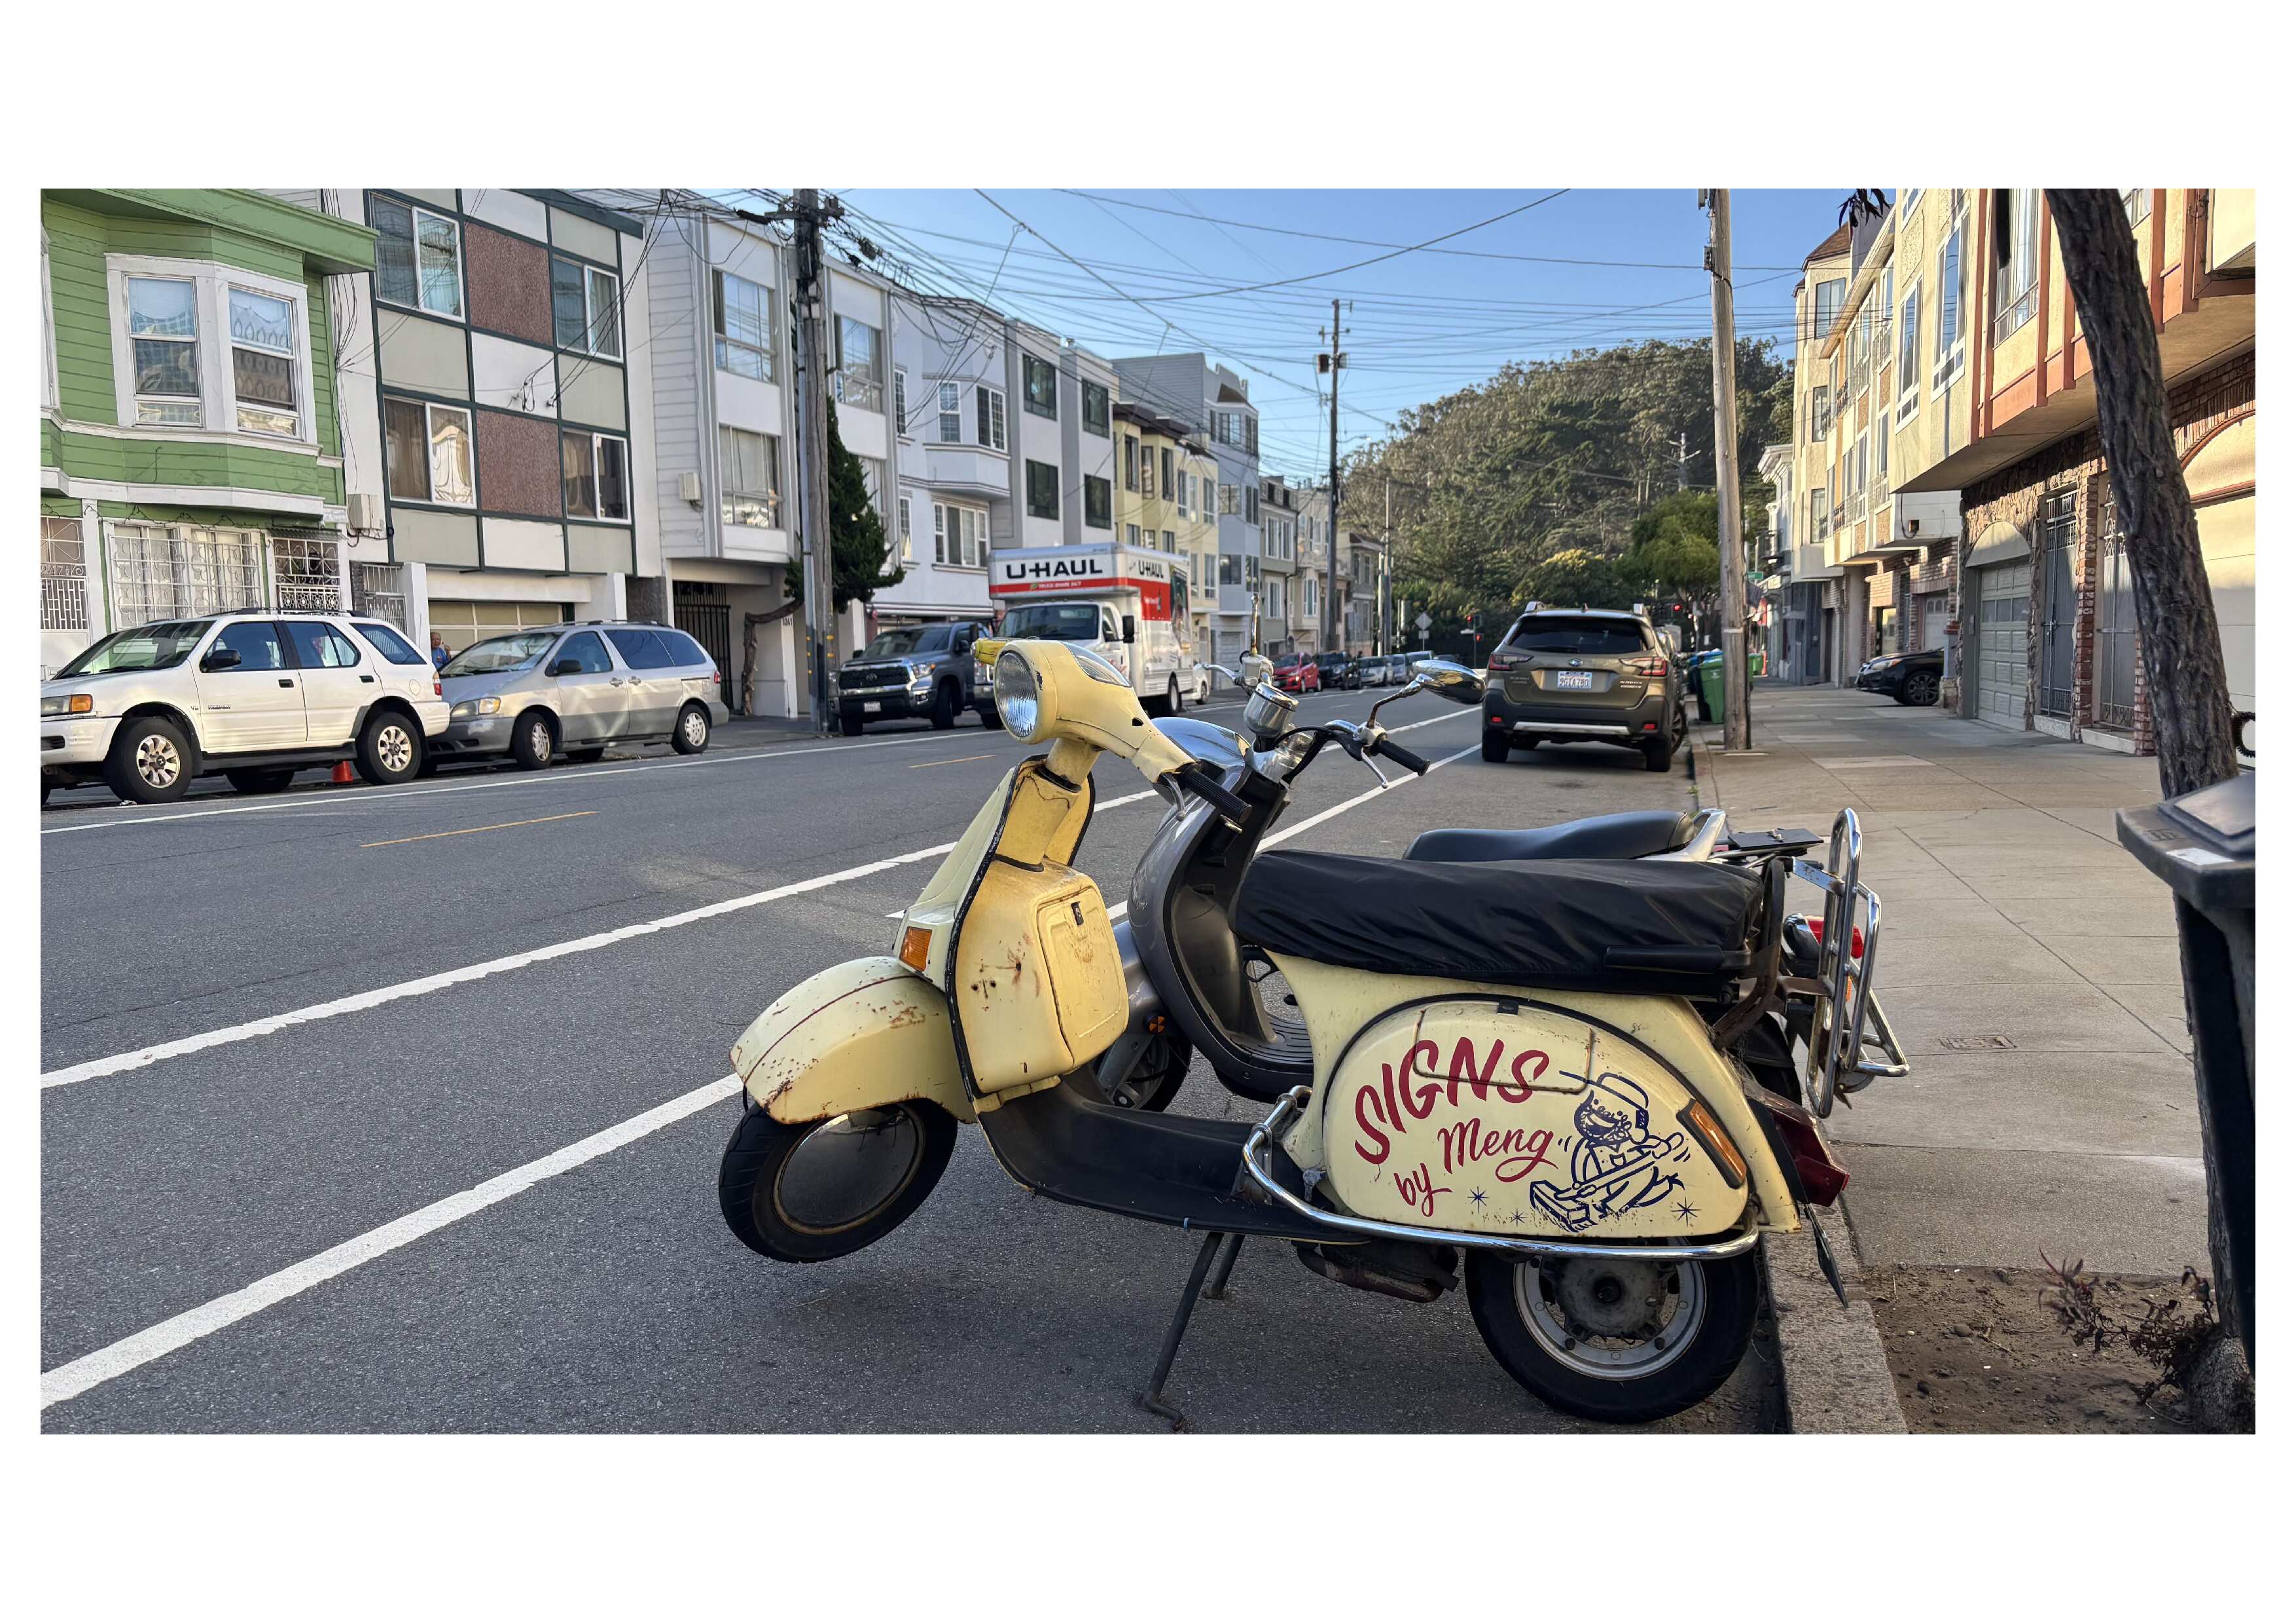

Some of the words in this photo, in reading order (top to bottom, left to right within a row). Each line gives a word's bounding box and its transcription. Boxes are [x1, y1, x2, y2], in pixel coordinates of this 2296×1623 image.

[1006, 559, 1103, 579] U-HAUL
[1138, 560, 1164, 578] U-HAUL
[1355, 1037, 1550, 1164] SIGNS
[1394, 1163, 1452, 1217] by
[1437, 1117, 1558, 1182] Meng
